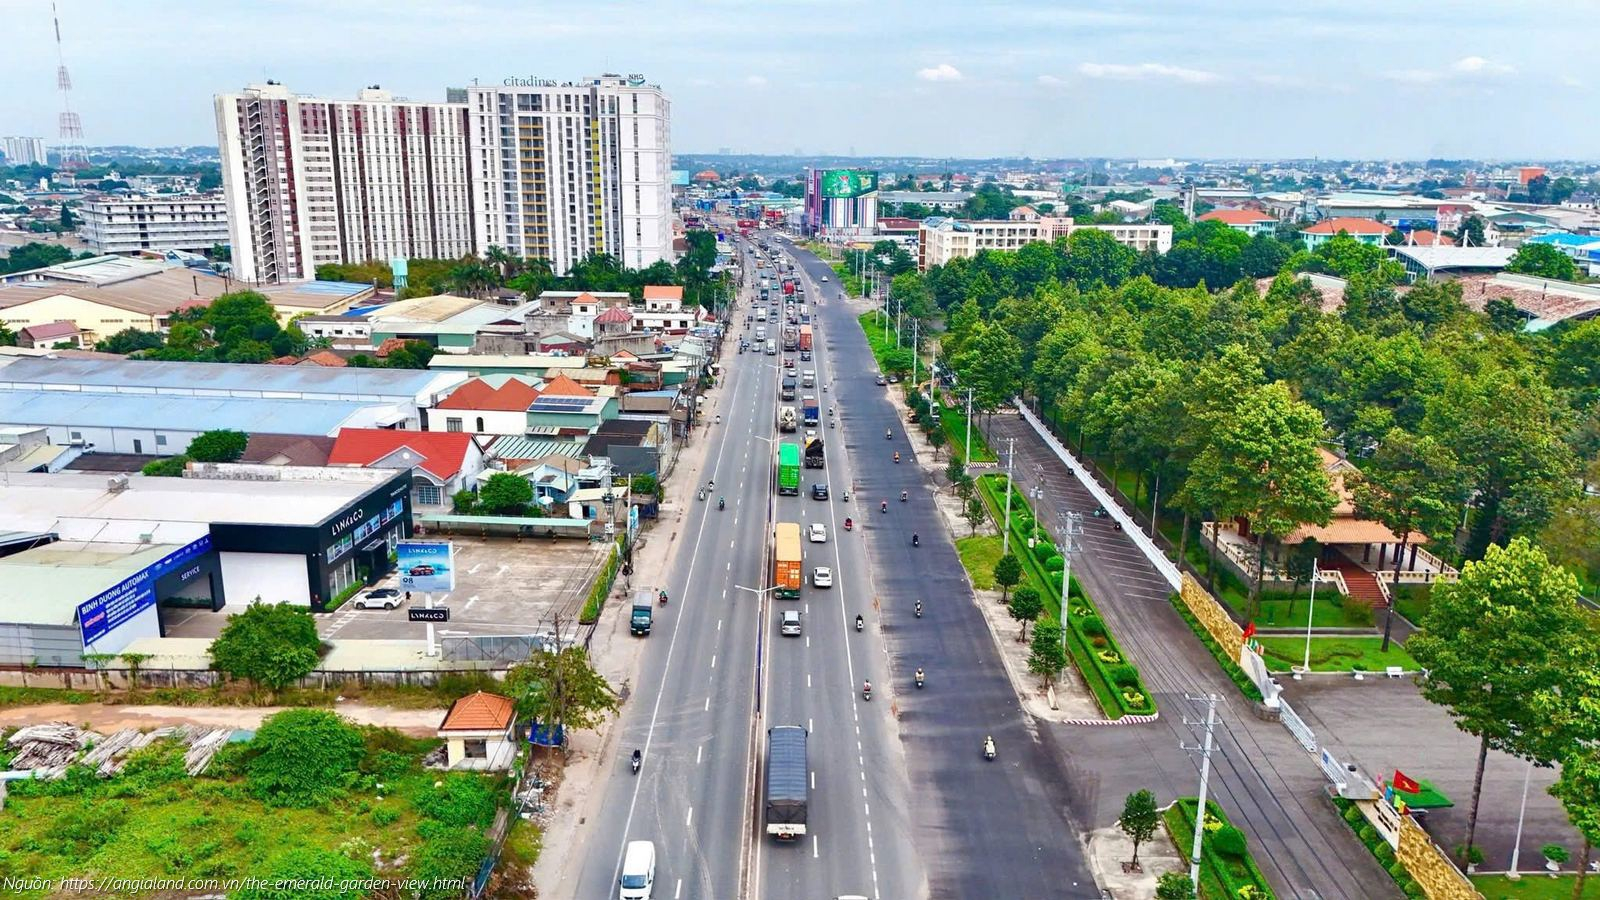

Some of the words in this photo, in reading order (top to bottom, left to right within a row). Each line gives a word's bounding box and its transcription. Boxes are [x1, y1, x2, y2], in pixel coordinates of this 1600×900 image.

[503, 75, 557, 87] citadines
[181, 565, 200, 580] SERVICE
[81, 601, 98, 614] BINH
[98, 588, 121, 605] DUONG
[121, 570, 149, 592] AUTOMAX
